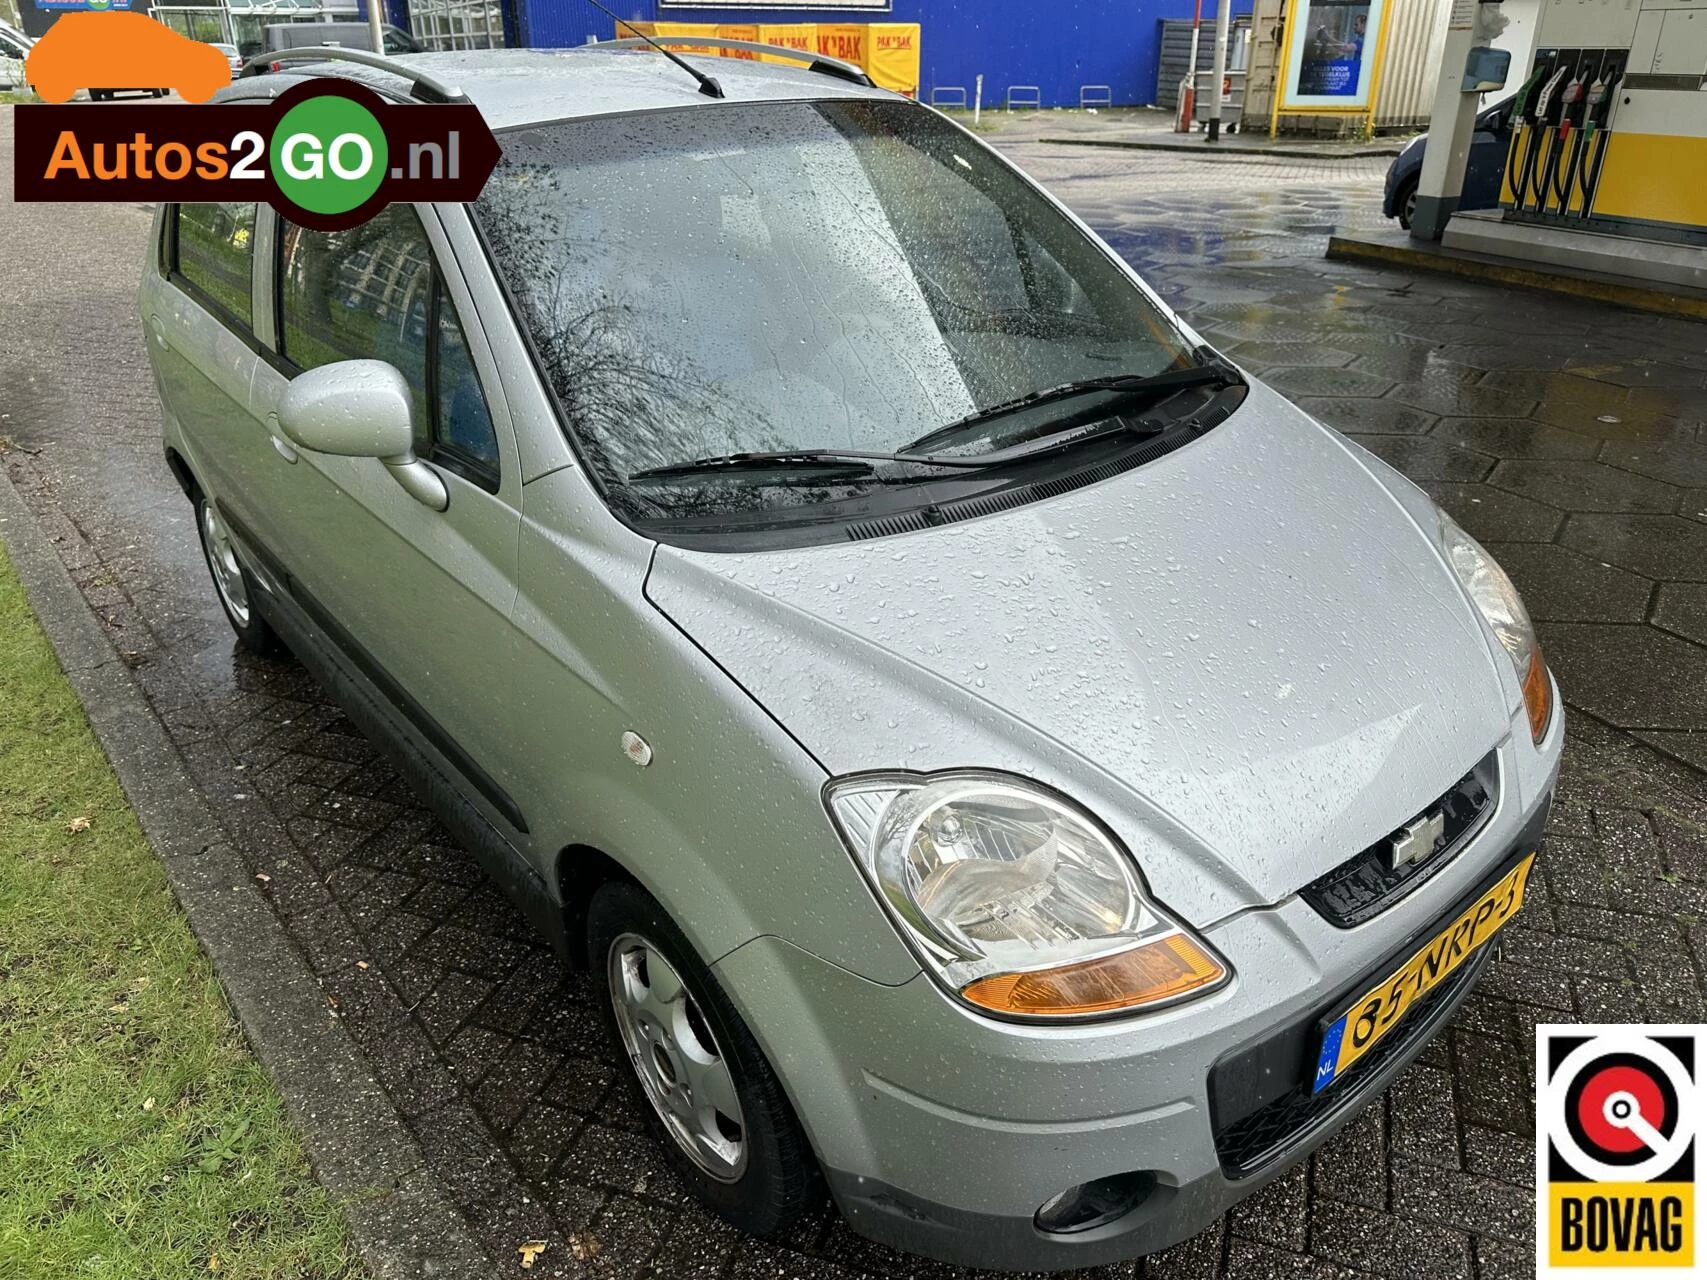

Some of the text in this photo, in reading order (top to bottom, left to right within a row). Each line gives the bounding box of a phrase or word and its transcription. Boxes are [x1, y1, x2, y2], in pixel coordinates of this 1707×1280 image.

[838, 35, 861, 61] BAK
[877, 36, 891, 47] PAK
[896, 36, 912, 48] BAK
[1353, 869, 1520, 1048] 85-NRP-3
[1316, 1060, 1334, 1080] NL
